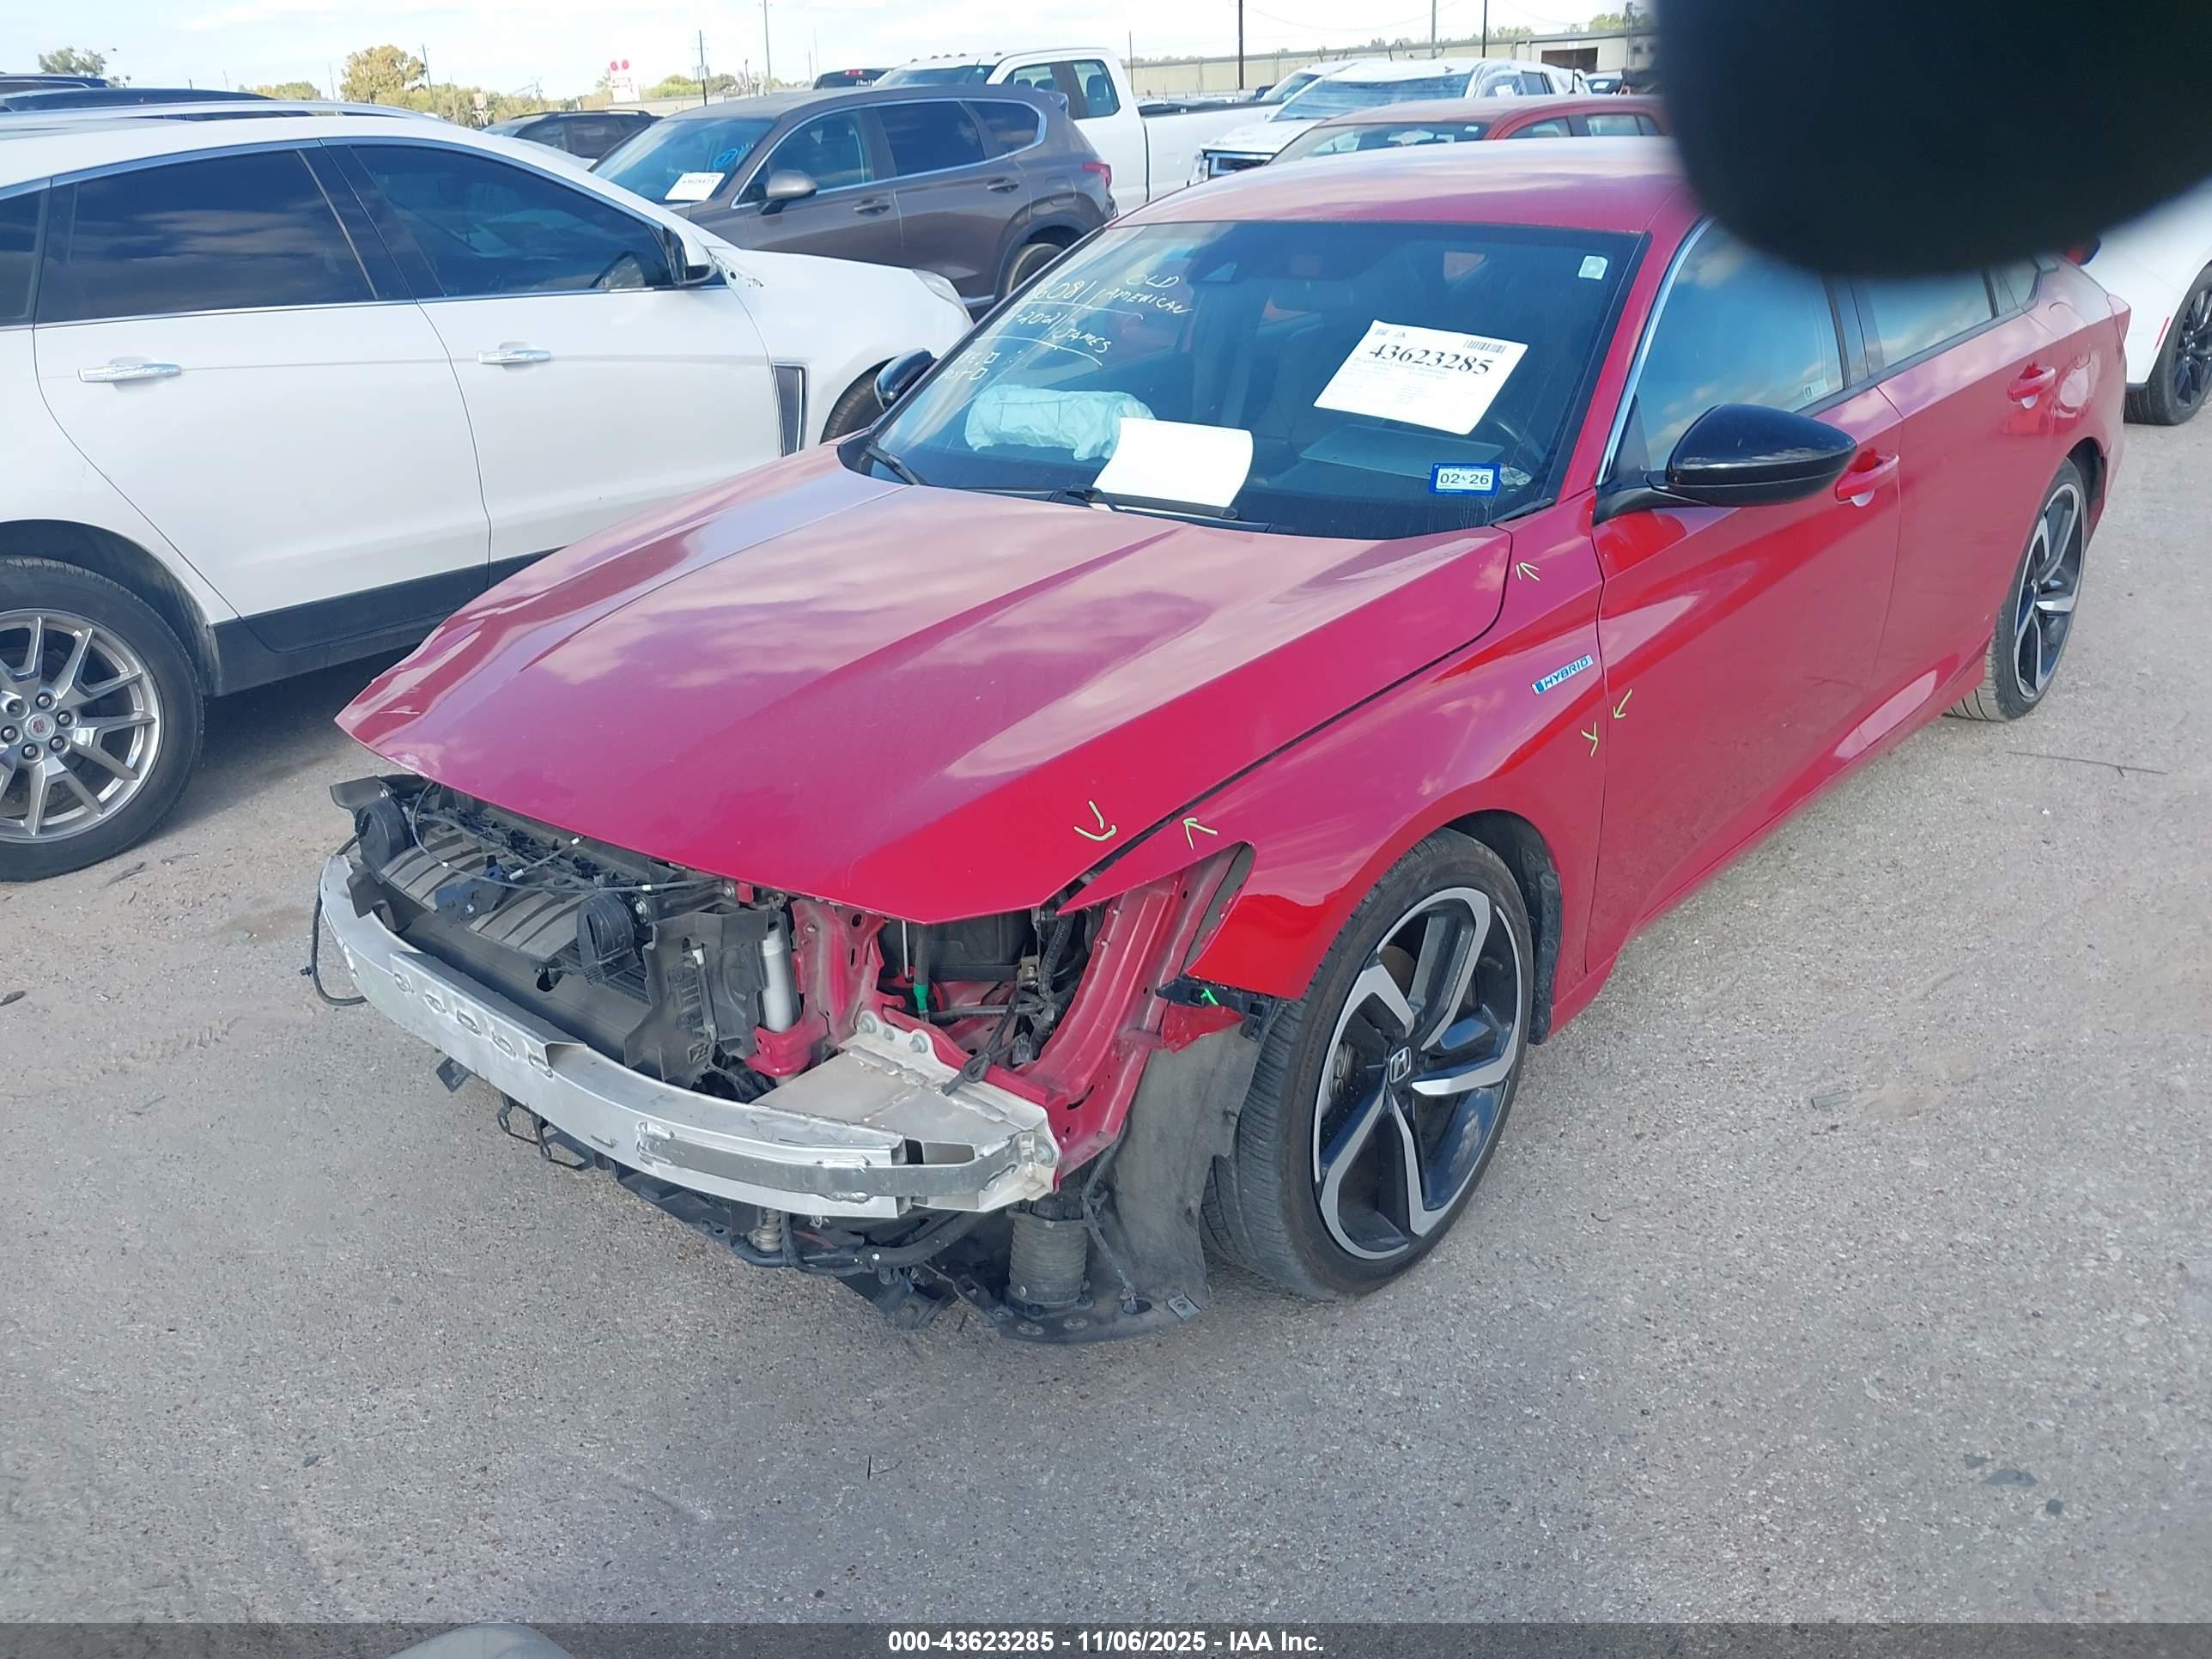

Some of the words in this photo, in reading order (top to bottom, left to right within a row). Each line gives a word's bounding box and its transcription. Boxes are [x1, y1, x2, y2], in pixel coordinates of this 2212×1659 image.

[1127, 274, 1179, 288] OLD
[1053, 328, 1112, 353] JAMES
[1370, 343, 1494, 374] 43623285
[1544, 657, 1589, 688] HYBRID
